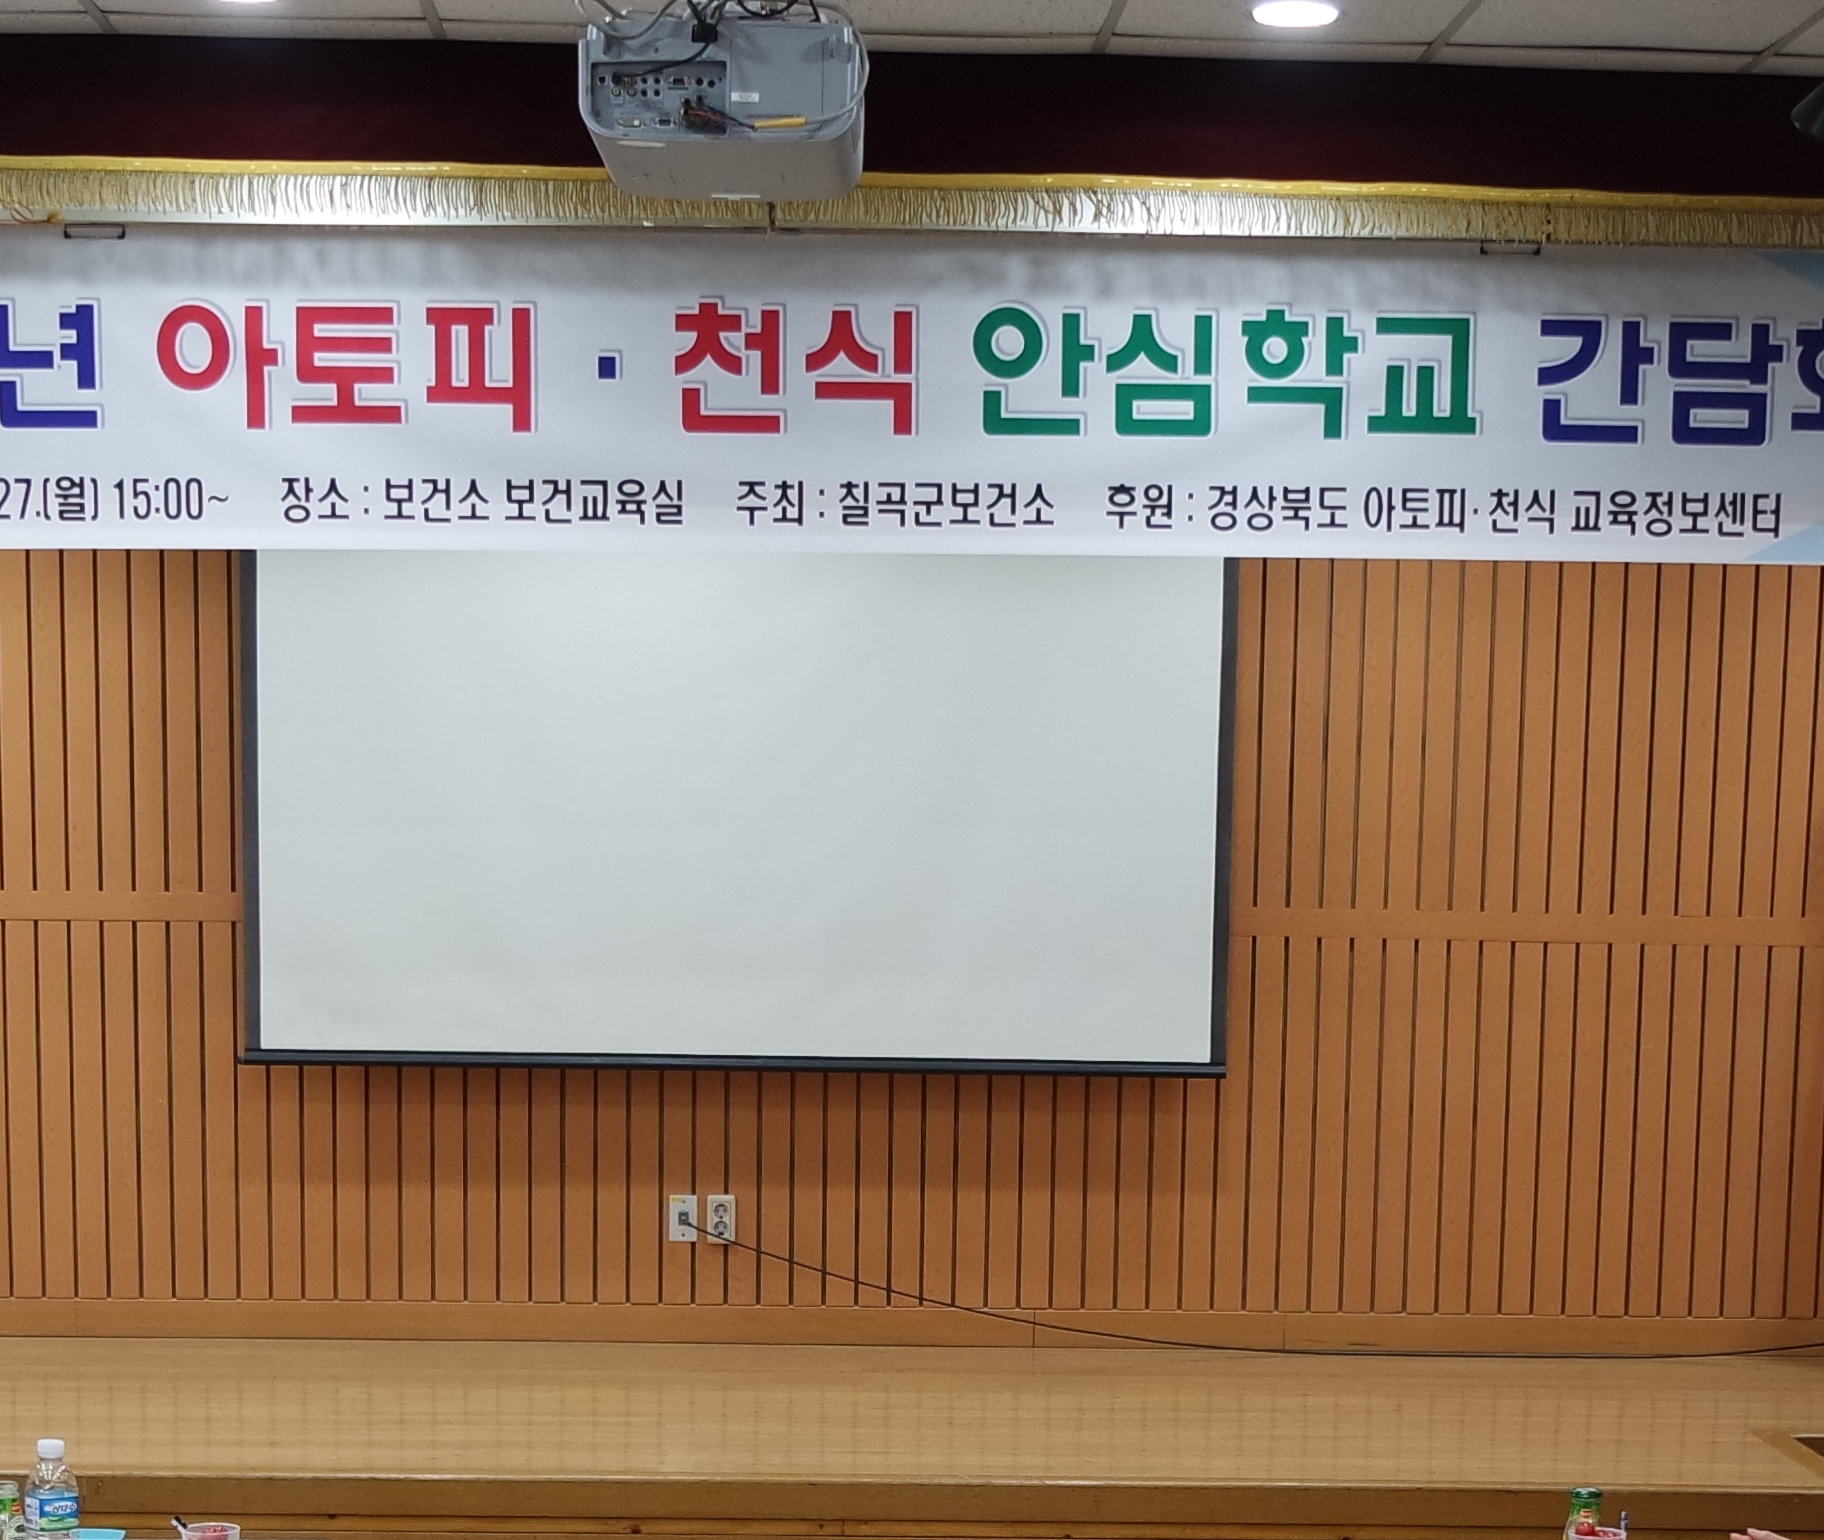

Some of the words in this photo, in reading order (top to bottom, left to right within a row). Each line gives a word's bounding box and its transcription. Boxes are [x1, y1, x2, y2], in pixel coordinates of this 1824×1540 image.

[156, 303, 533, 432] 아토피
[674, 297, 914, 437] 천식
[972, 305, 1482, 440] 안심학교
[113, 477, 229, 520] 15:00~
[281, 476, 349, 523] 장소
[384, 478, 489, 523] 보건소
[505, 478, 683, 525] 보건교육실
[736, 480, 804, 526] 주최
[839, 480, 1055, 527] 칠곡군보건소
[1106, 483, 1173, 529] 후원
[1208, 485, 1348, 530] 경상북도
[1570, 489, 1782, 539] 교육정보센터
